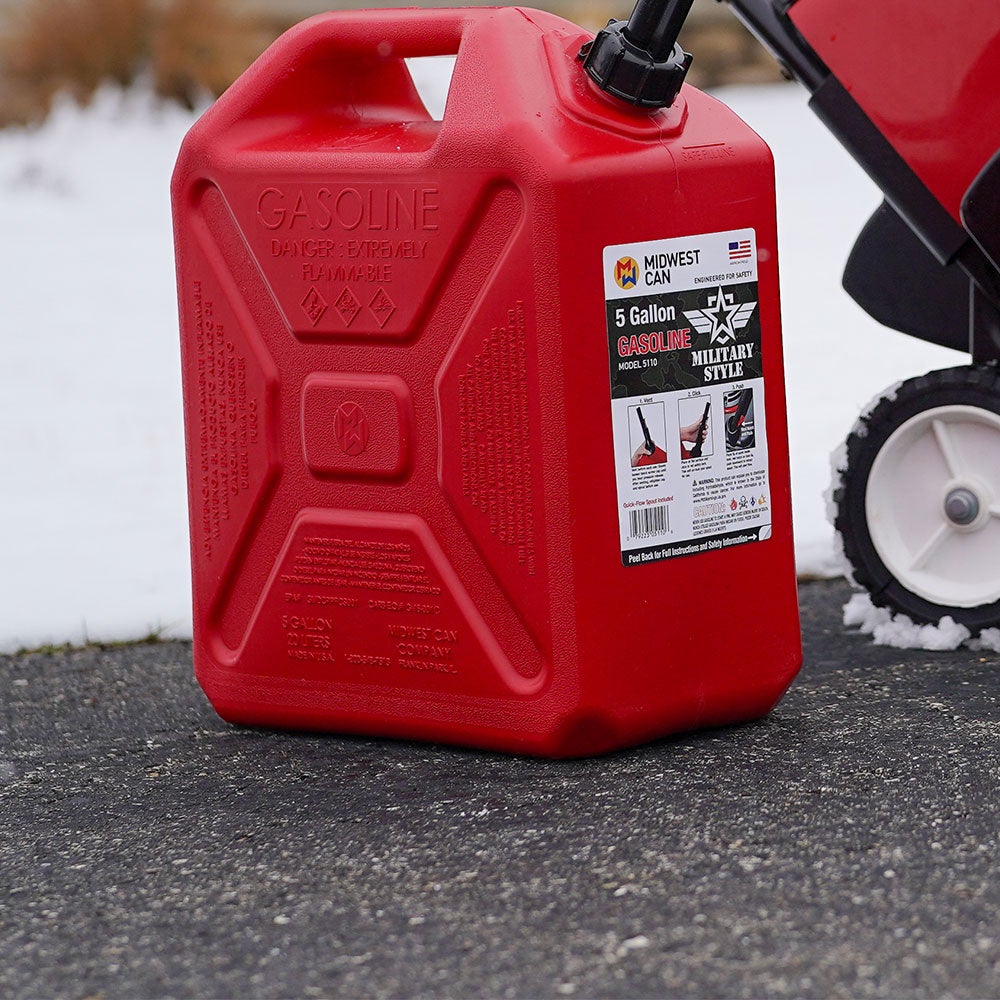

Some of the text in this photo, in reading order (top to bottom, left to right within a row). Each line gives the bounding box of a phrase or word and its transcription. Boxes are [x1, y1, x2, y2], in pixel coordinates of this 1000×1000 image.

[256, 187, 439, 231] GASOLINE
[271, 238, 335, 257] DANGER
[347, 239, 429, 259] EXTREMELY
[644, 249, 700, 271] MIDWEST
[302, 263, 392, 282] FLAMMABLE
[645, 270, 671, 287] CAN
[694, 270, 752, 284] ENGINEERED FOR SAFETY
[193, 280, 205, 355] INFLAMABLE
[204, 301, 212, 316] DE
[615, 305, 676, 328] 5 Gallon
[617, 328, 692, 358] GASOLINE
[618, 358, 658, 371] MODEL 5110
[691, 342, 754, 367] MILITARY
[217, 350, 225, 395] NUNCA
[703, 362, 744, 382] STYLE
[237, 356, 246, 411] PRENDER
[208, 381, 217, 449] PRODUCTO
[239, 415, 248, 448] PARA
[628, 534, 748, 564] Peel Back for Full Instructions and Safety Information
[434, 628, 458, 641] CAN
[396, 642, 451, 658] COMPANY
